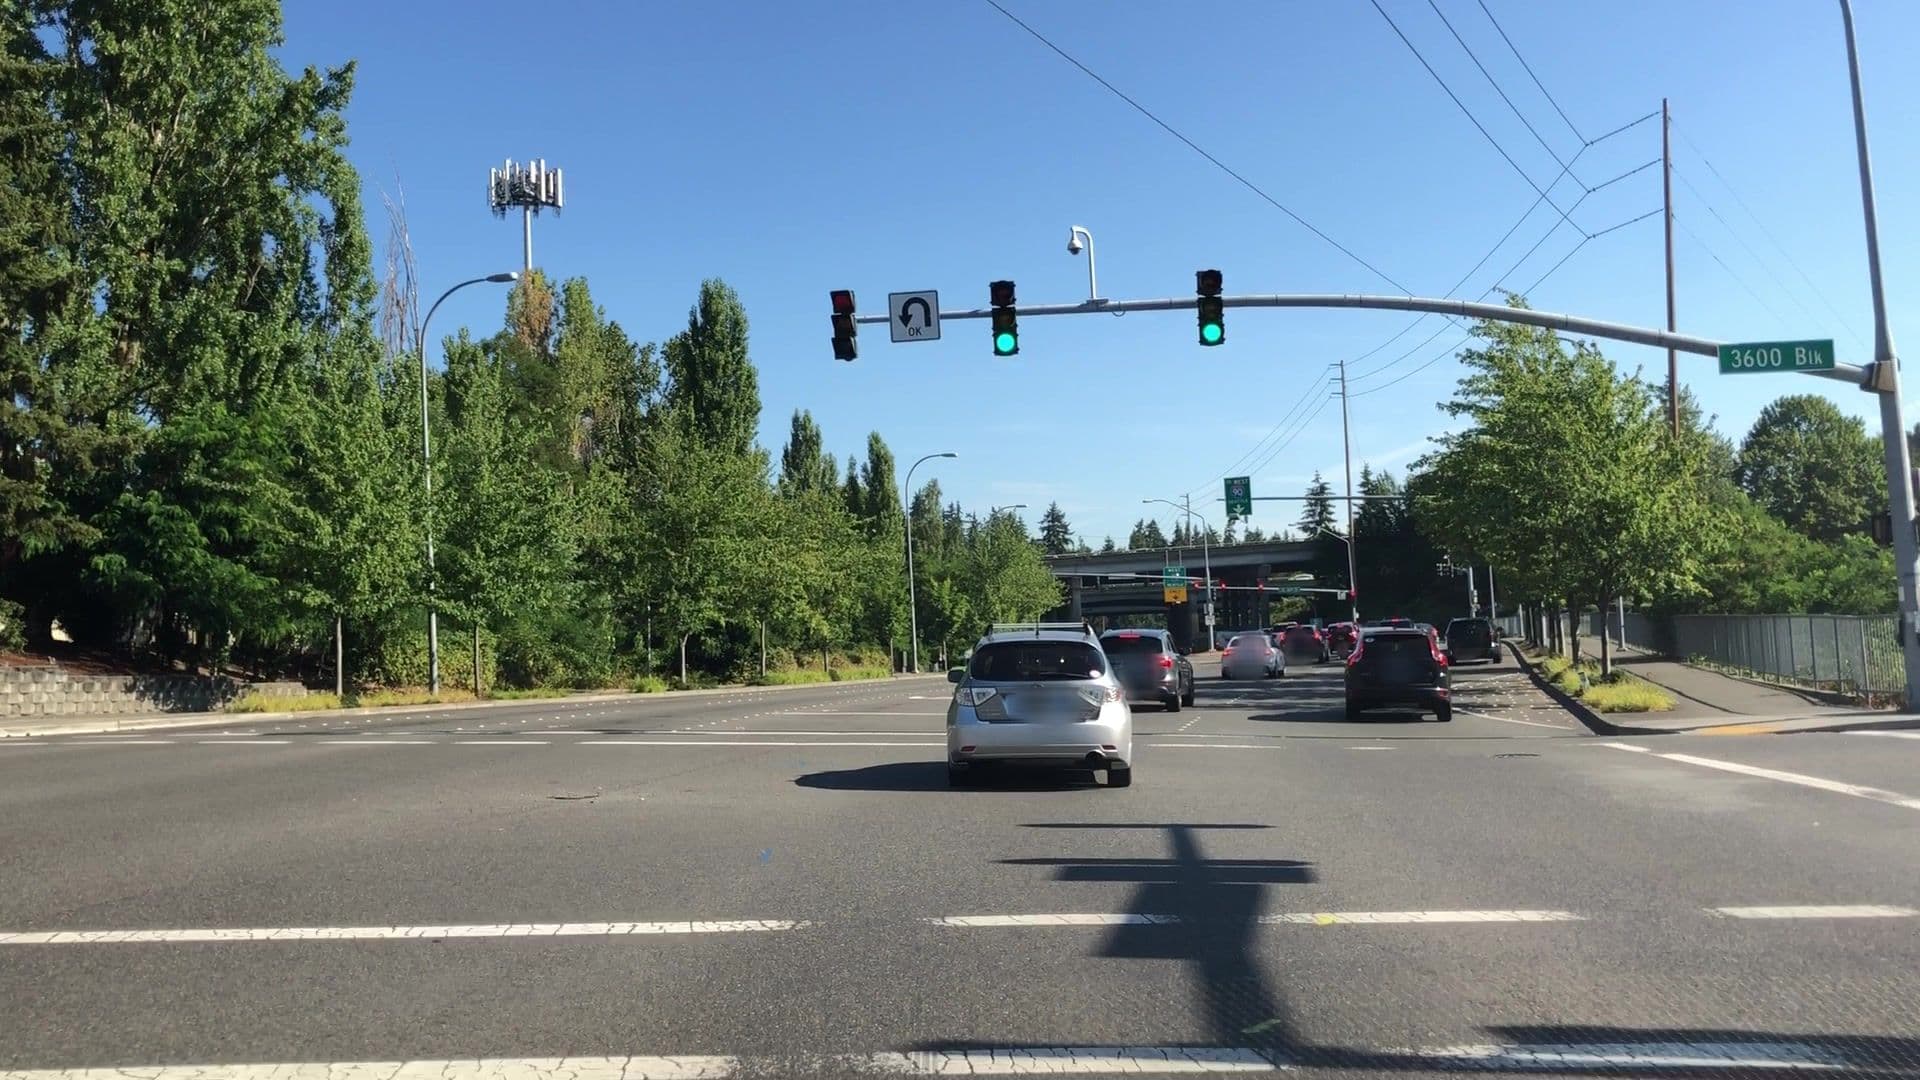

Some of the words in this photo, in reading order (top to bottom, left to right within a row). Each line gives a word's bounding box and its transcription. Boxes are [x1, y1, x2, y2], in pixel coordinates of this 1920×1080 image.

[908, 327, 922, 336] OK
[1730, 348, 1782, 368] 3600
[1232, 487, 1243, 496] 90
